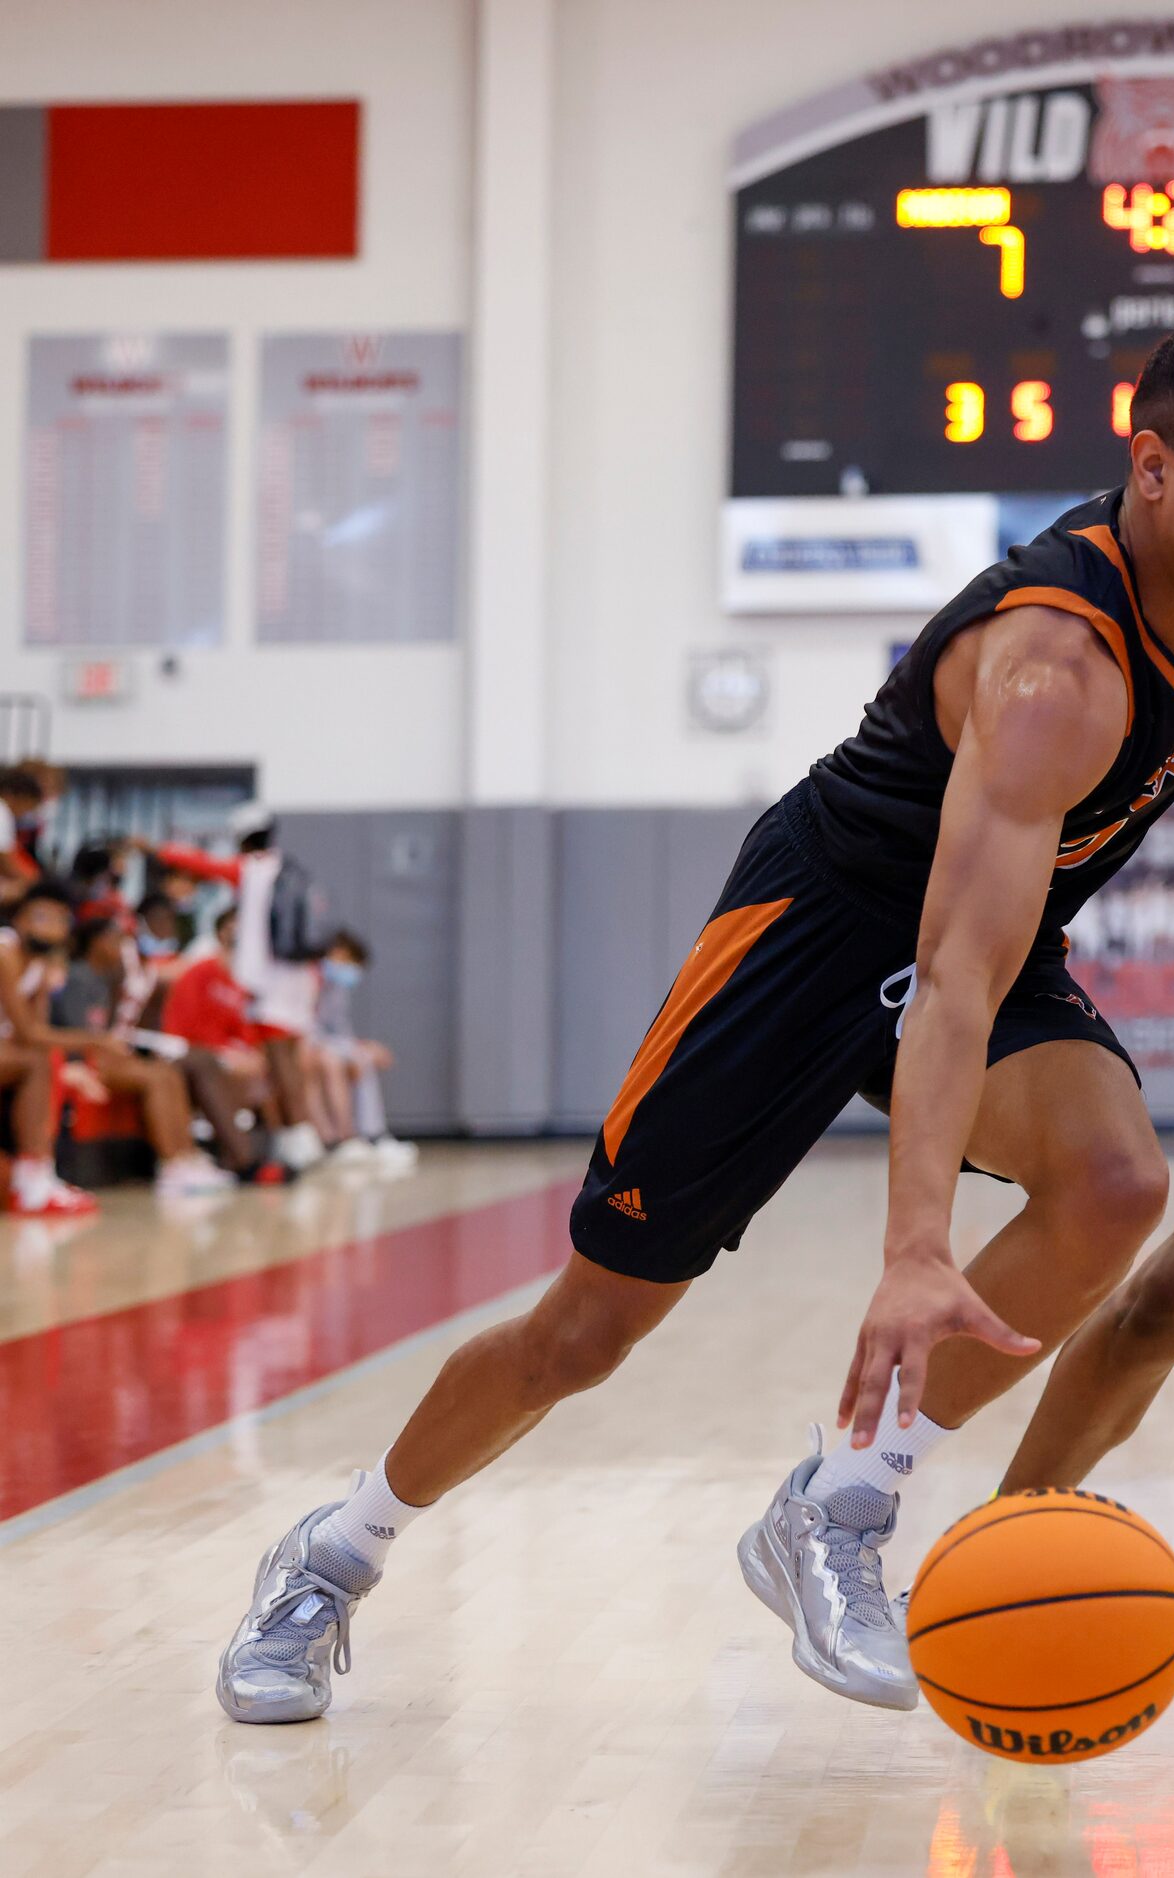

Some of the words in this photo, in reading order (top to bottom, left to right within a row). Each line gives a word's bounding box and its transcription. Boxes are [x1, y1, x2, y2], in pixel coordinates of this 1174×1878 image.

[924, 88, 1092, 184] WILD
[978, 226, 1025, 299] 7
[944, 382, 986, 444] 3
[1010, 380, 1054, 443] 5
[607, 1196, 647, 1221] adidas
[966, 1702, 1156, 1756] Wilson
